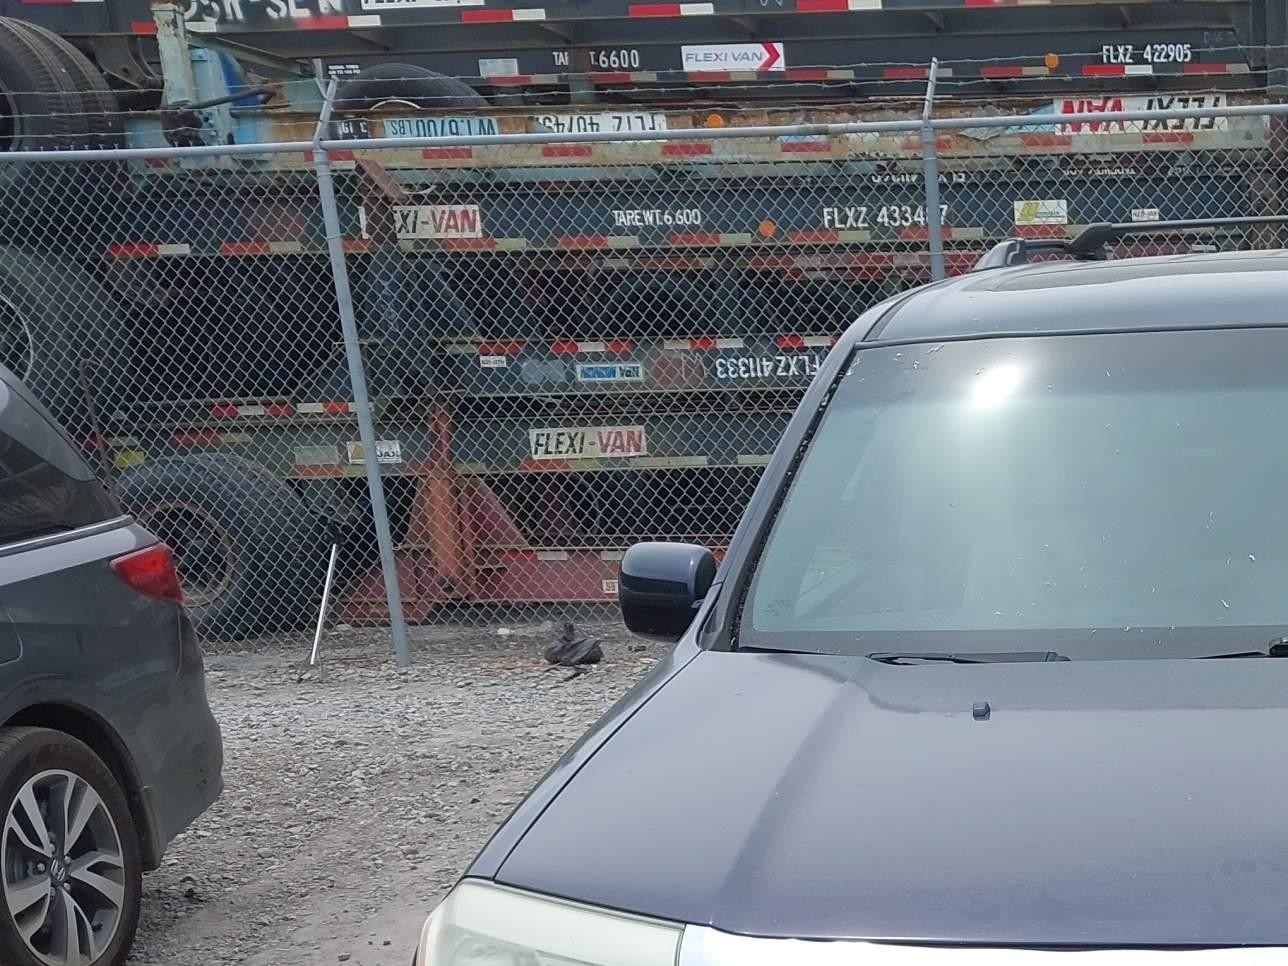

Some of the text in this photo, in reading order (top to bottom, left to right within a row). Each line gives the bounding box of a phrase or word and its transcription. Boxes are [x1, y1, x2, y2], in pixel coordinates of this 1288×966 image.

[685, 51, 763, 63] FLEXI VAN
[1102, 44, 1192, 63] FLXZ 422905
[823, 204, 949, 228] FLXZ 43347
[715, 356, 773, 379] 411333
